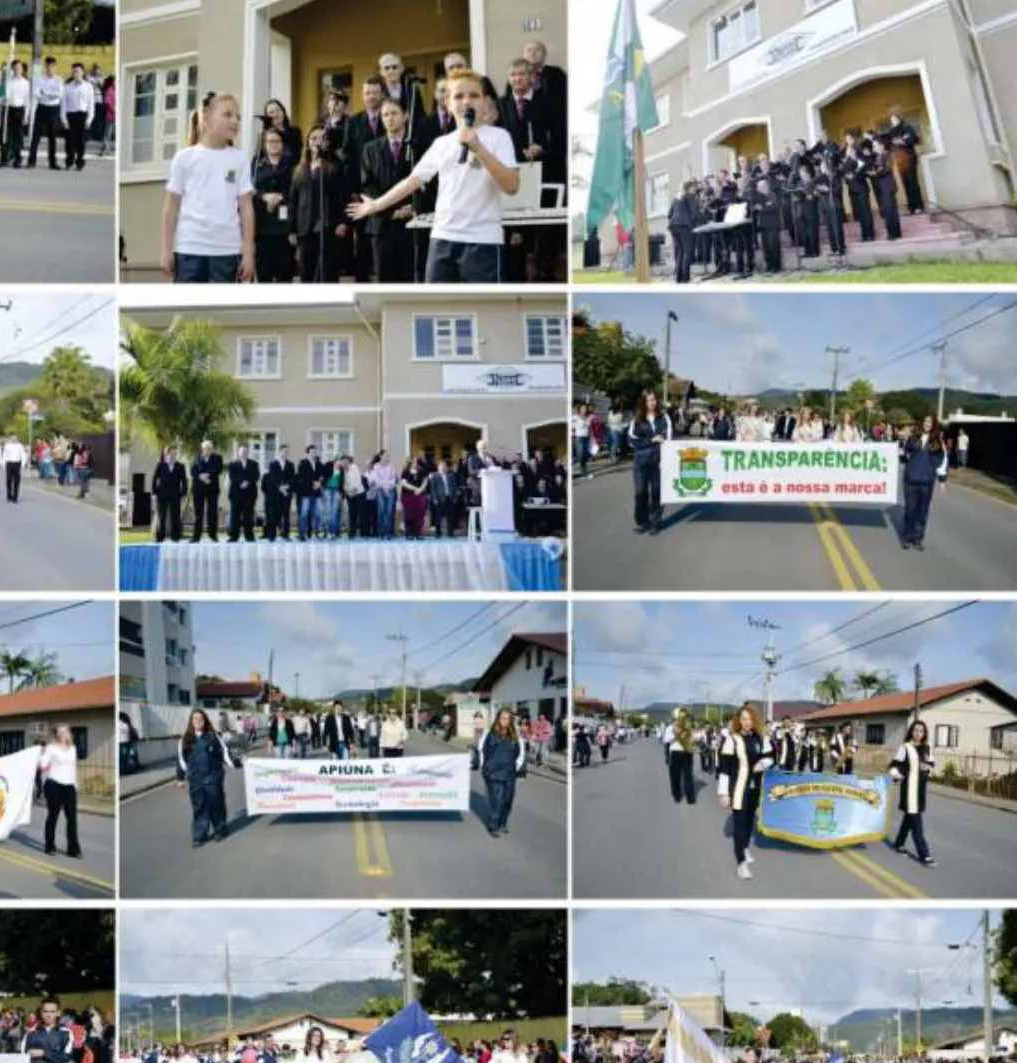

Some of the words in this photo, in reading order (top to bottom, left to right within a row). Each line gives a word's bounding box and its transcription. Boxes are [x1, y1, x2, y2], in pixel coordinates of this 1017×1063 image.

[721, 448, 887, 472] TRANSPARÊNCIA:
[722, 481, 754, 493] esta
[759, 480, 768, 493] é
[773, 484, 782, 493] a
[786, 484, 830, 493] nossa
[835, 482, 887, 494] marca!
[319, 763, 373, 775] APIÚNA
